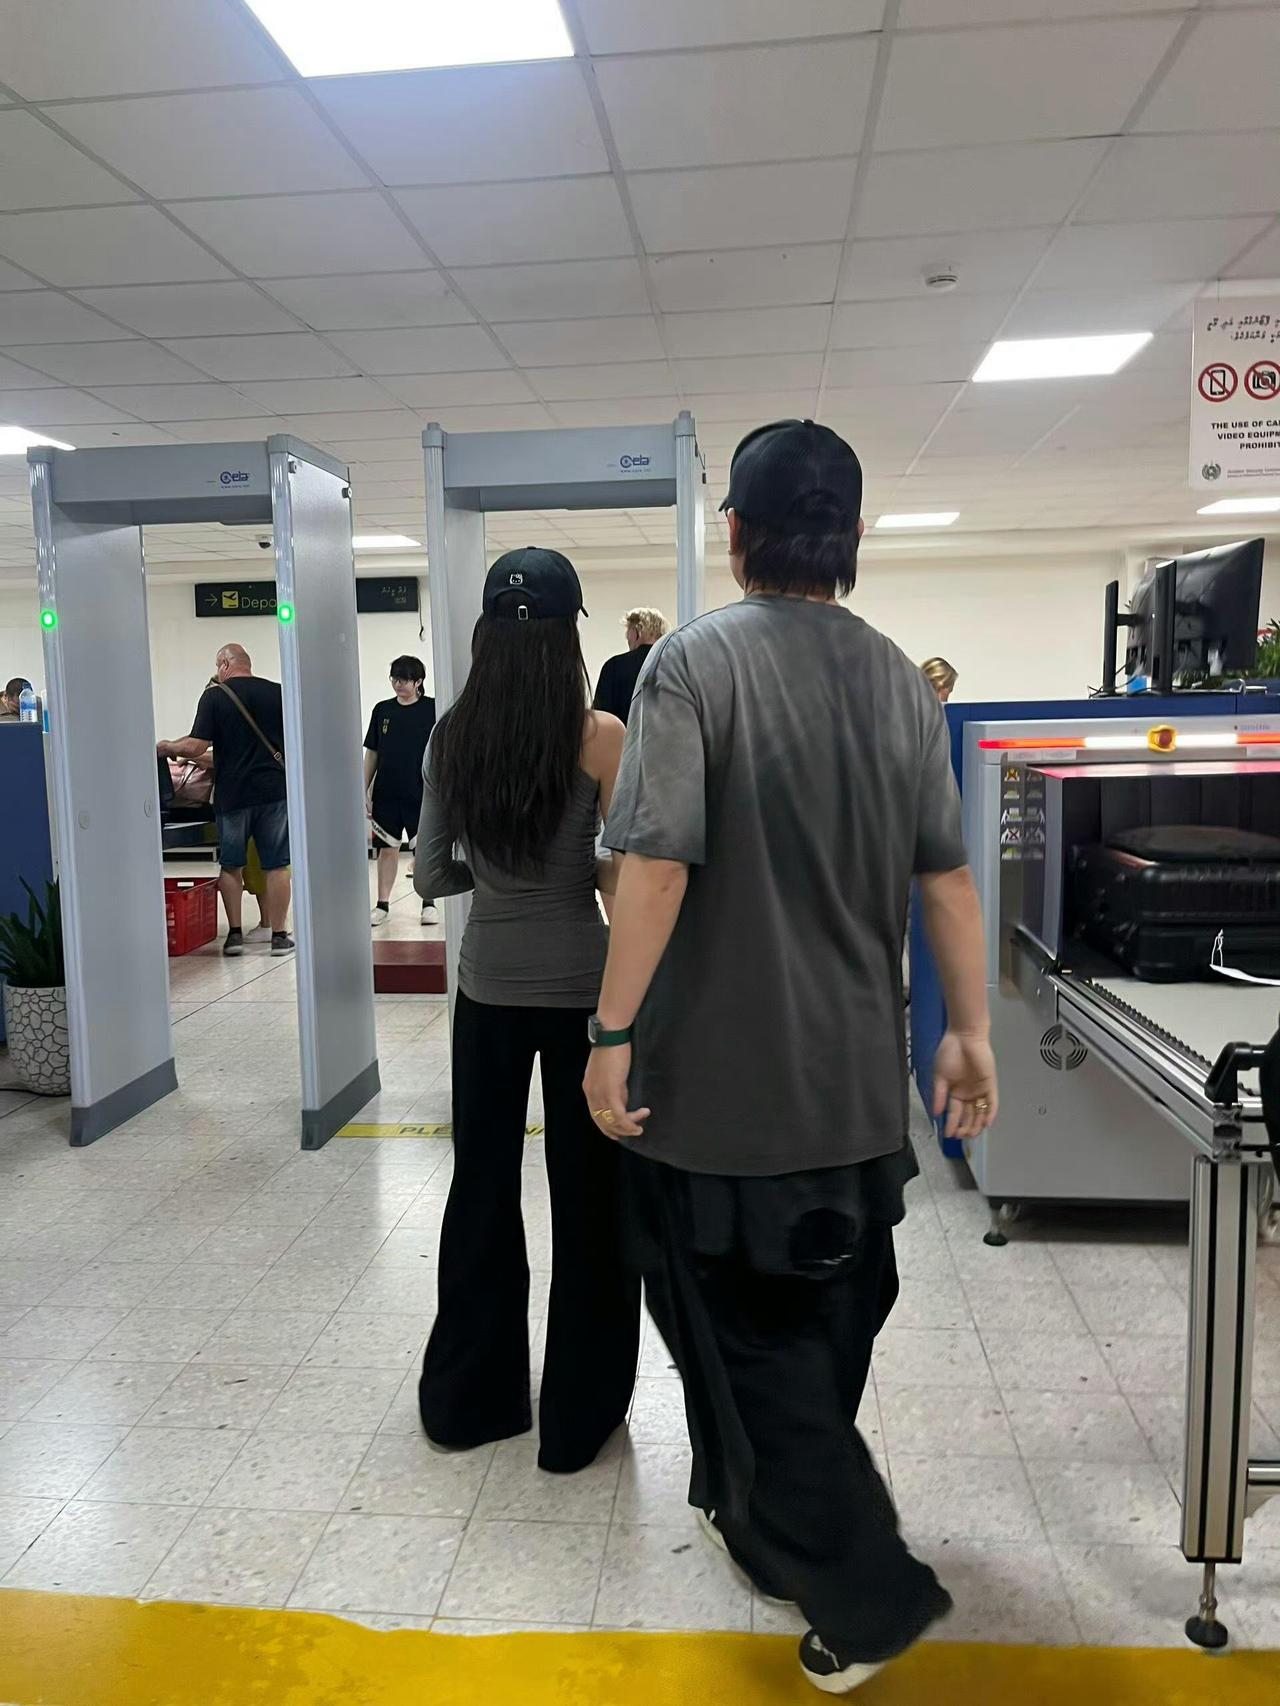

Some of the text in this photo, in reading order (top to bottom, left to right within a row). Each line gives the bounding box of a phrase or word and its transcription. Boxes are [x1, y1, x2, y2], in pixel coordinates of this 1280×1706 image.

[1211, 422, 1228, 430] THE
[1231, 421, 1249, 429] USE
[1251, 420, 1263, 428] OF
[1217, 432, 1245, 440] VIDEO
